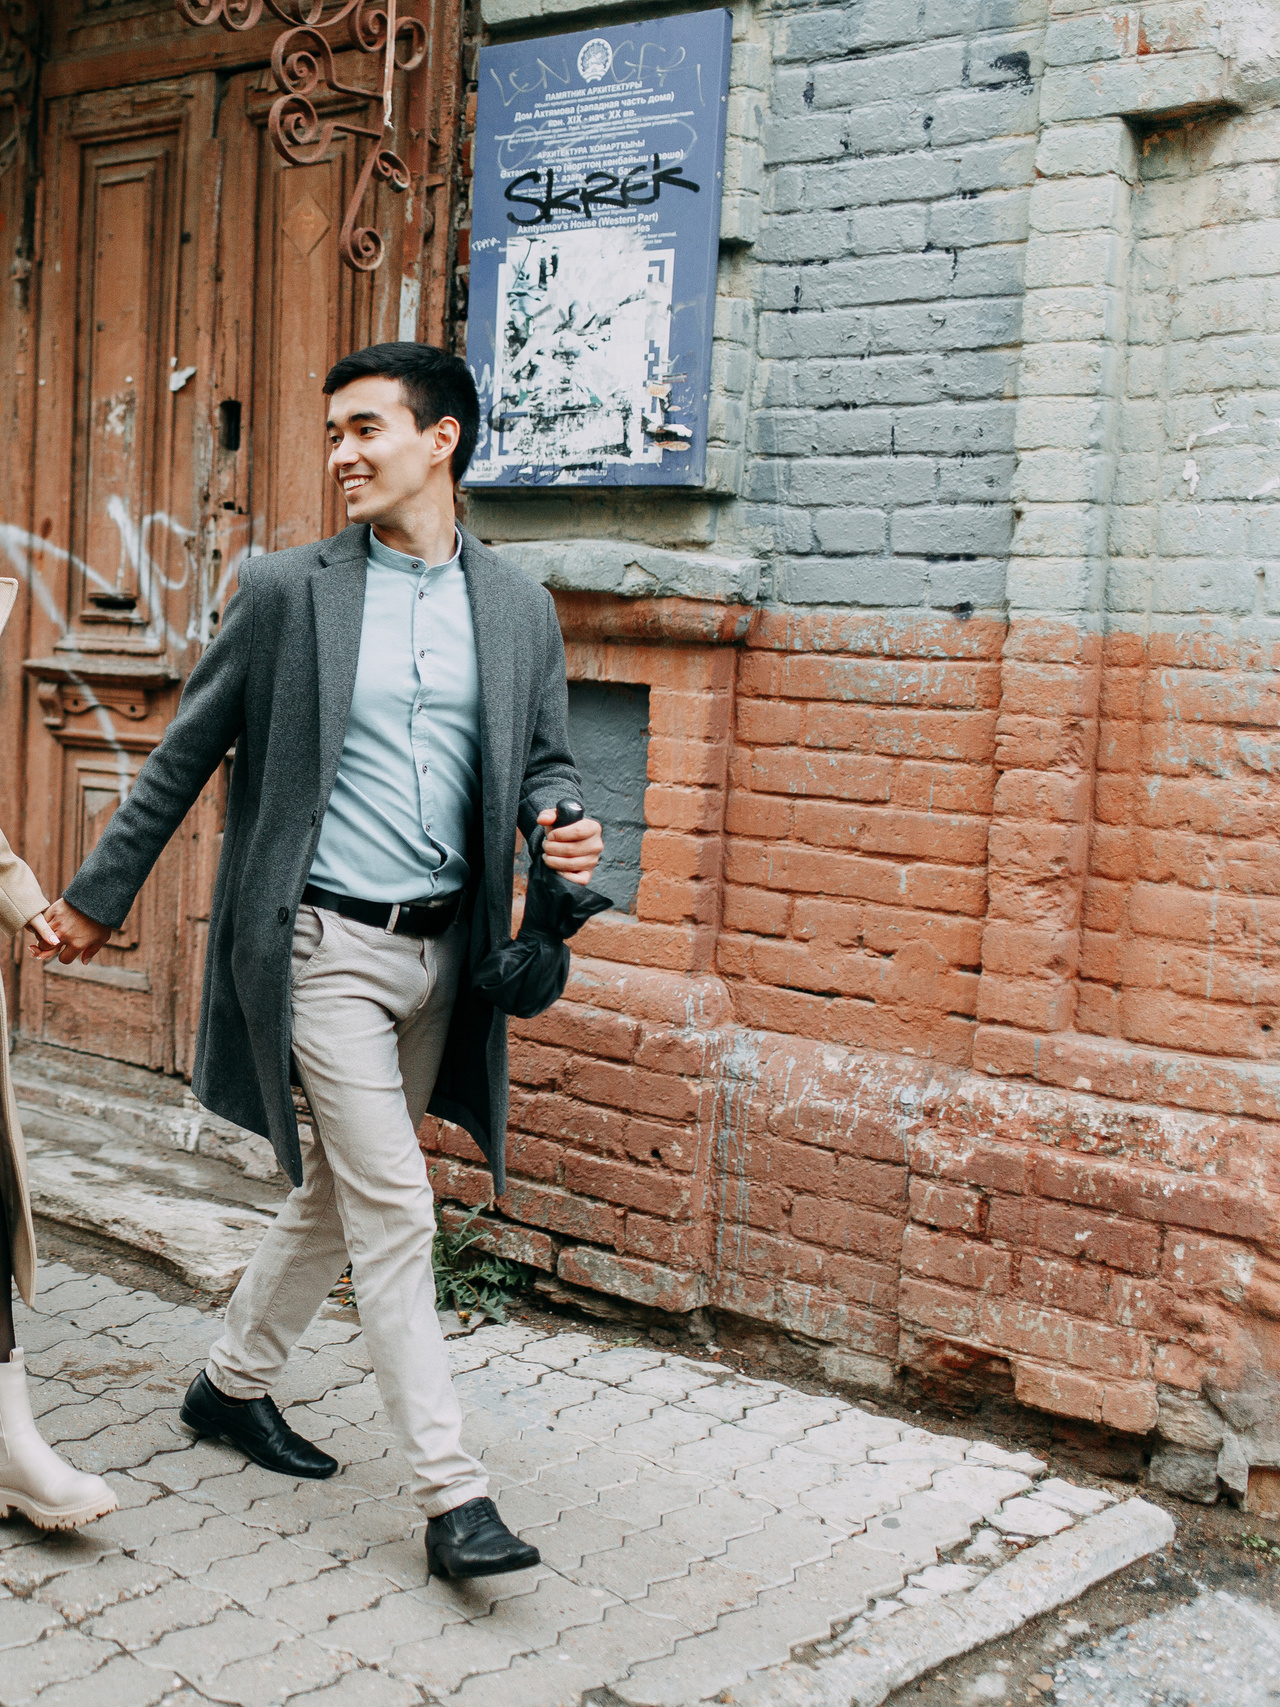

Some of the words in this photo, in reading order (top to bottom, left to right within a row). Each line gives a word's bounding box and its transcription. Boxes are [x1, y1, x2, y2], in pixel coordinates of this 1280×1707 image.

[545, 88, 587, 101] ПАМЯТНИК
[587, 80, 643, 96] АРХИТЕКТУРЫ
[514, 111, 532, 123] Дом
[533, 106, 575, 119] Ахтямова
[576, 100, 620, 114] (западная
[621, 96, 647, 107] часть
[647, 90, 675, 105] дома)
[567, 115, 582, 125] XIX
[589, 114, 606, 122] нач.
[608, 109, 622, 119] XX
[622, 109, 637, 117] вв.
[537, 147, 588, 160] АРХИТЕКТУРА
[537, 165, 562, 174] йото
[570, 218, 597, 229] House
[598, 214, 636, 227] (Western
[638, 211, 659, 223] Part)
